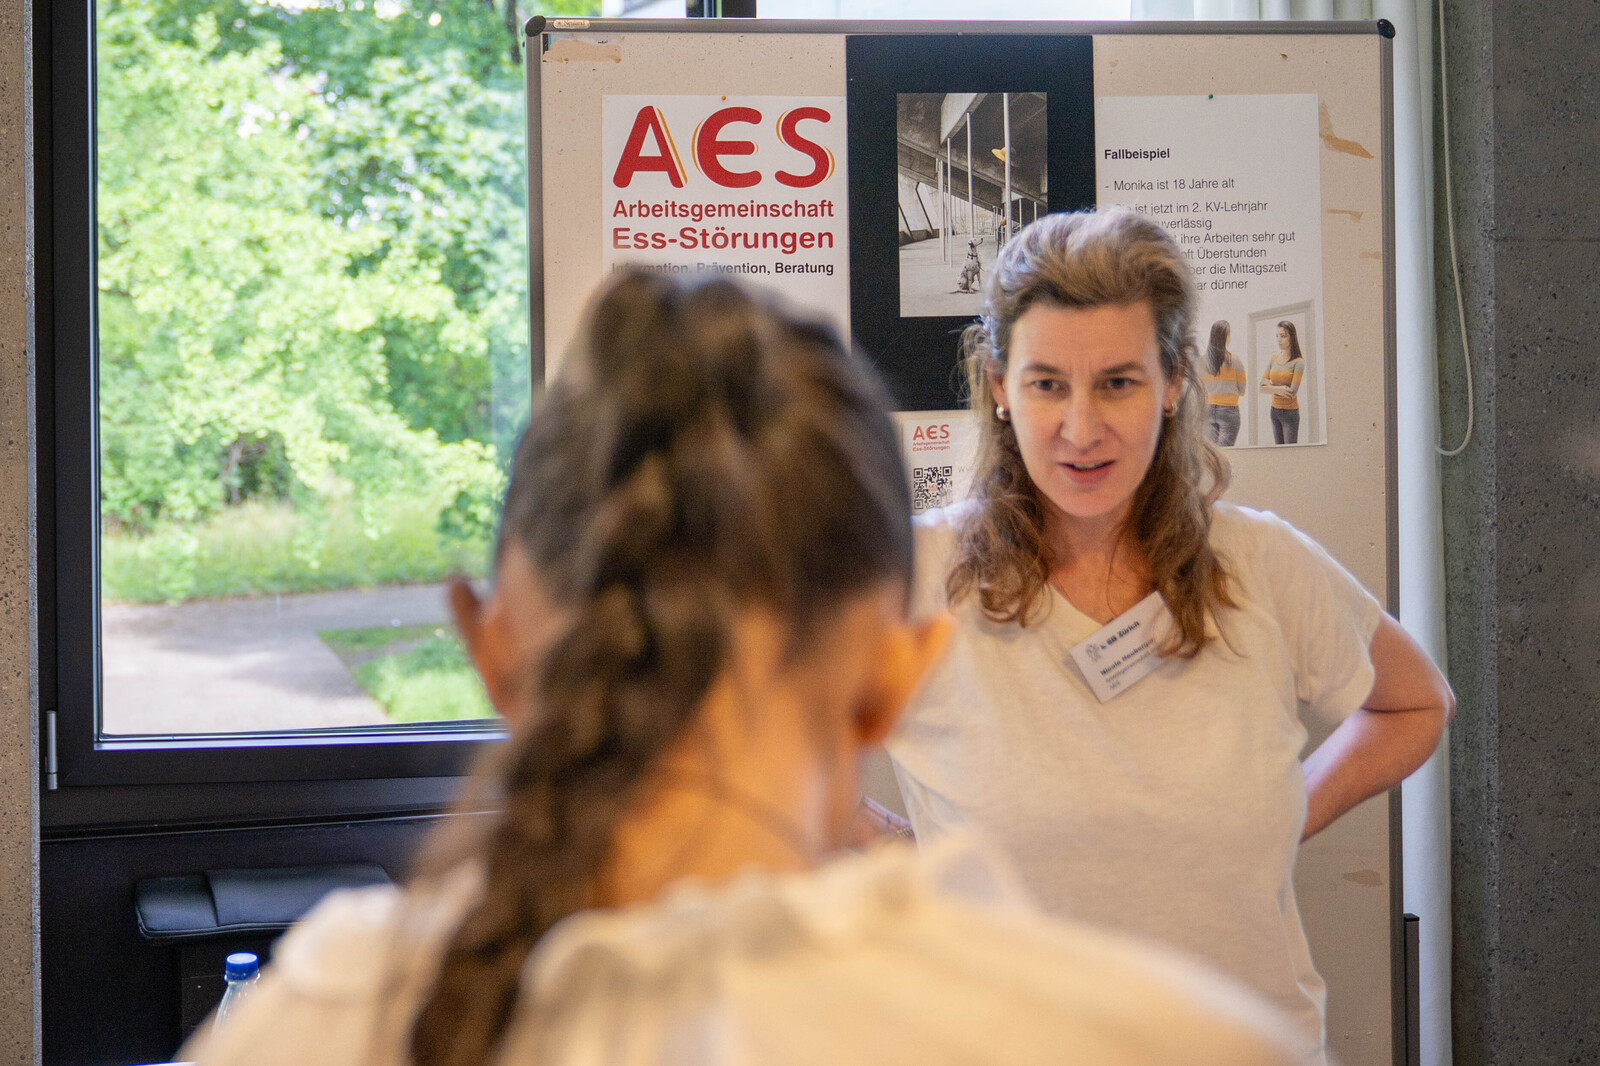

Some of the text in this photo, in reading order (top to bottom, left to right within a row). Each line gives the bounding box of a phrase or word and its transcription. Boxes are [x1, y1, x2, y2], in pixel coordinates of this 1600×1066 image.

[612, 105, 836, 189] AES
[1104, 148, 1170, 161] Fallbeispiel
[1113, 179, 1154, 191] Monika
[1156, 179, 1169, 190] ist
[1173, 178, 1186, 190] 18
[1188, 178, 1219, 190] Jahre
[1221, 177, 1235, 189] alt
[612, 199, 834, 222] Arbeitsgemeinschaft
[1135, 203, 1147, 214] ist
[1150, 203, 1174, 216] jetzt
[1176, 202, 1189, 213] im
[1192, 202, 1202, 213] 2.
[1205, 200, 1268, 214] KV-Lehrjahr
[1155, 217, 1212, 231] verlässig
[612, 226, 834, 254] Ess-Störungen
[1180, 233, 1201, 245] ihre
[1203, 232, 1249, 245] Arbeiten
[1251, 231, 1275, 243] sehr
[1278, 231, 1296, 245] gut
[1197, 246, 1267, 260] Überstunden
[697, 262, 771, 276] Prävention,
[774, 262, 834, 277] Beratung
[1189, 261, 1287, 275] ber die Mittagszeit
[1210, 279, 1249, 291] dünner
[912, 424, 951, 441] AES
